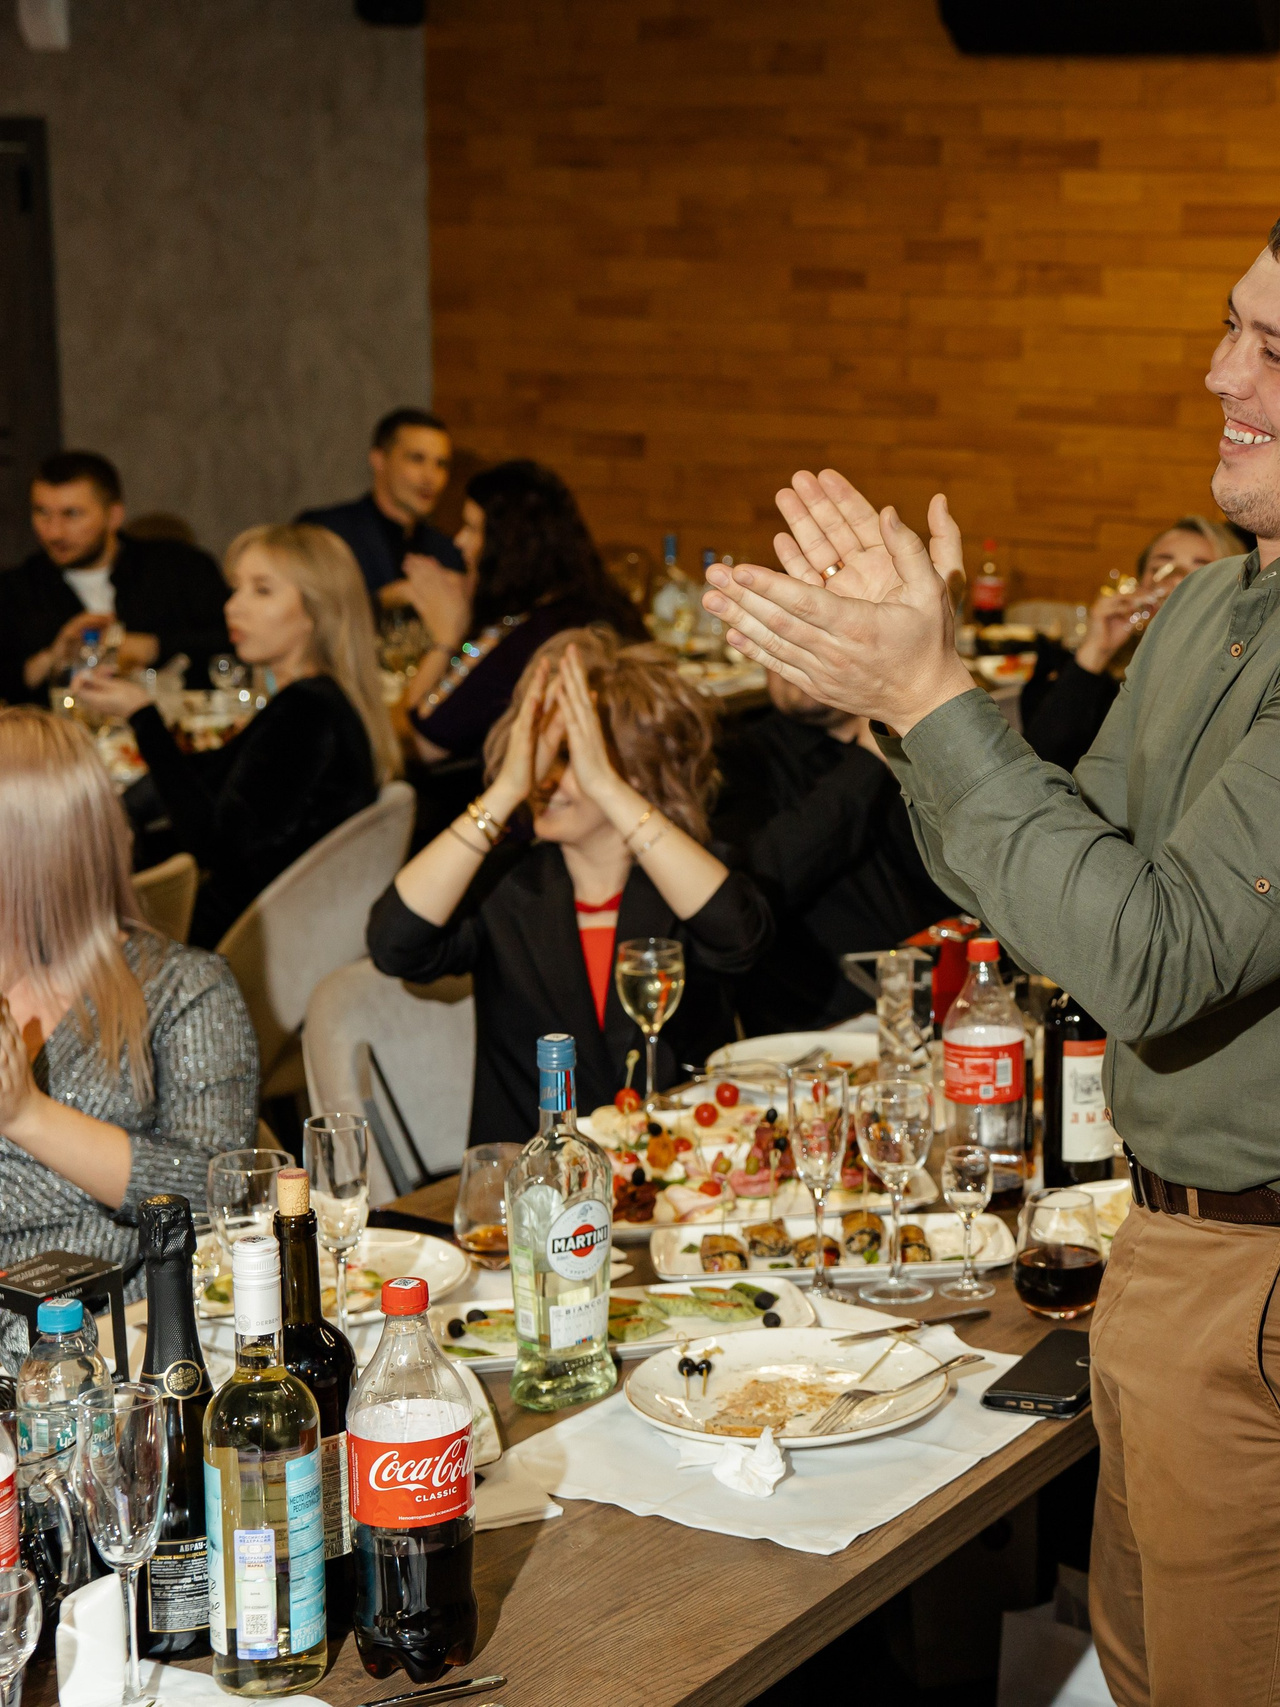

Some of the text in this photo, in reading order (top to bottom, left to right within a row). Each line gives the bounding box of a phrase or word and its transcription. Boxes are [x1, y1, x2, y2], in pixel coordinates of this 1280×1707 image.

[553, 1226, 607, 1253] MARTINI
[565, 1298, 601, 1315] BIANCO
[368, 1435, 473, 1492] Coca-Cola
[415, 1486, 457, 1503] CLASSIC
[179, 1542, 208, 1553] АБРАУ-
